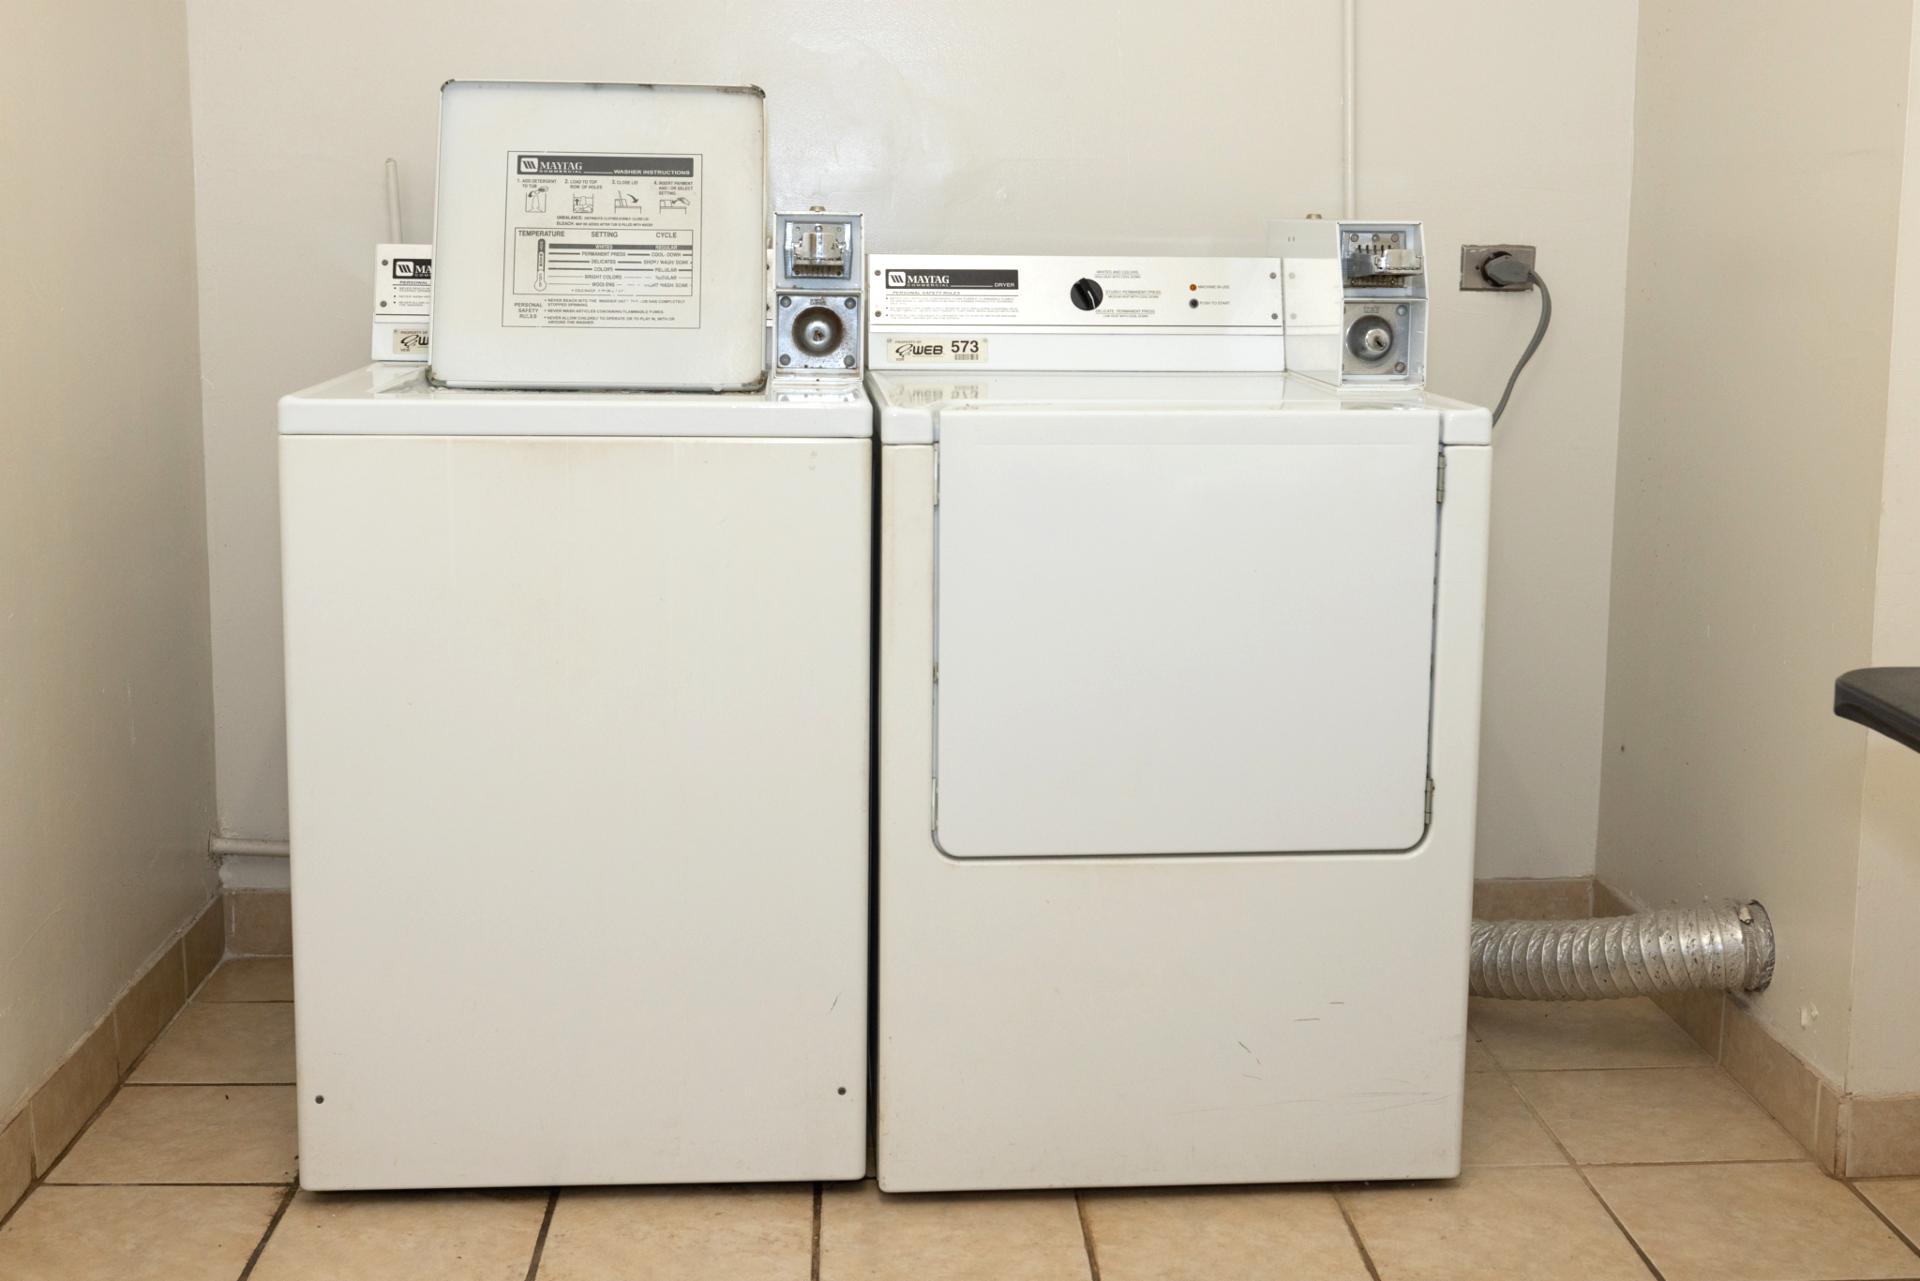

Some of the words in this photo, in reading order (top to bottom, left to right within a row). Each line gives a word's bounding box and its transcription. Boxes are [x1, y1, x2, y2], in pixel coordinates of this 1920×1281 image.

[540, 161, 583, 170] MAYTAG
[907, 275, 950, 284] MAYTAG
[912, 345, 943, 355] WEB
[951, 340, 979, 353] 573
